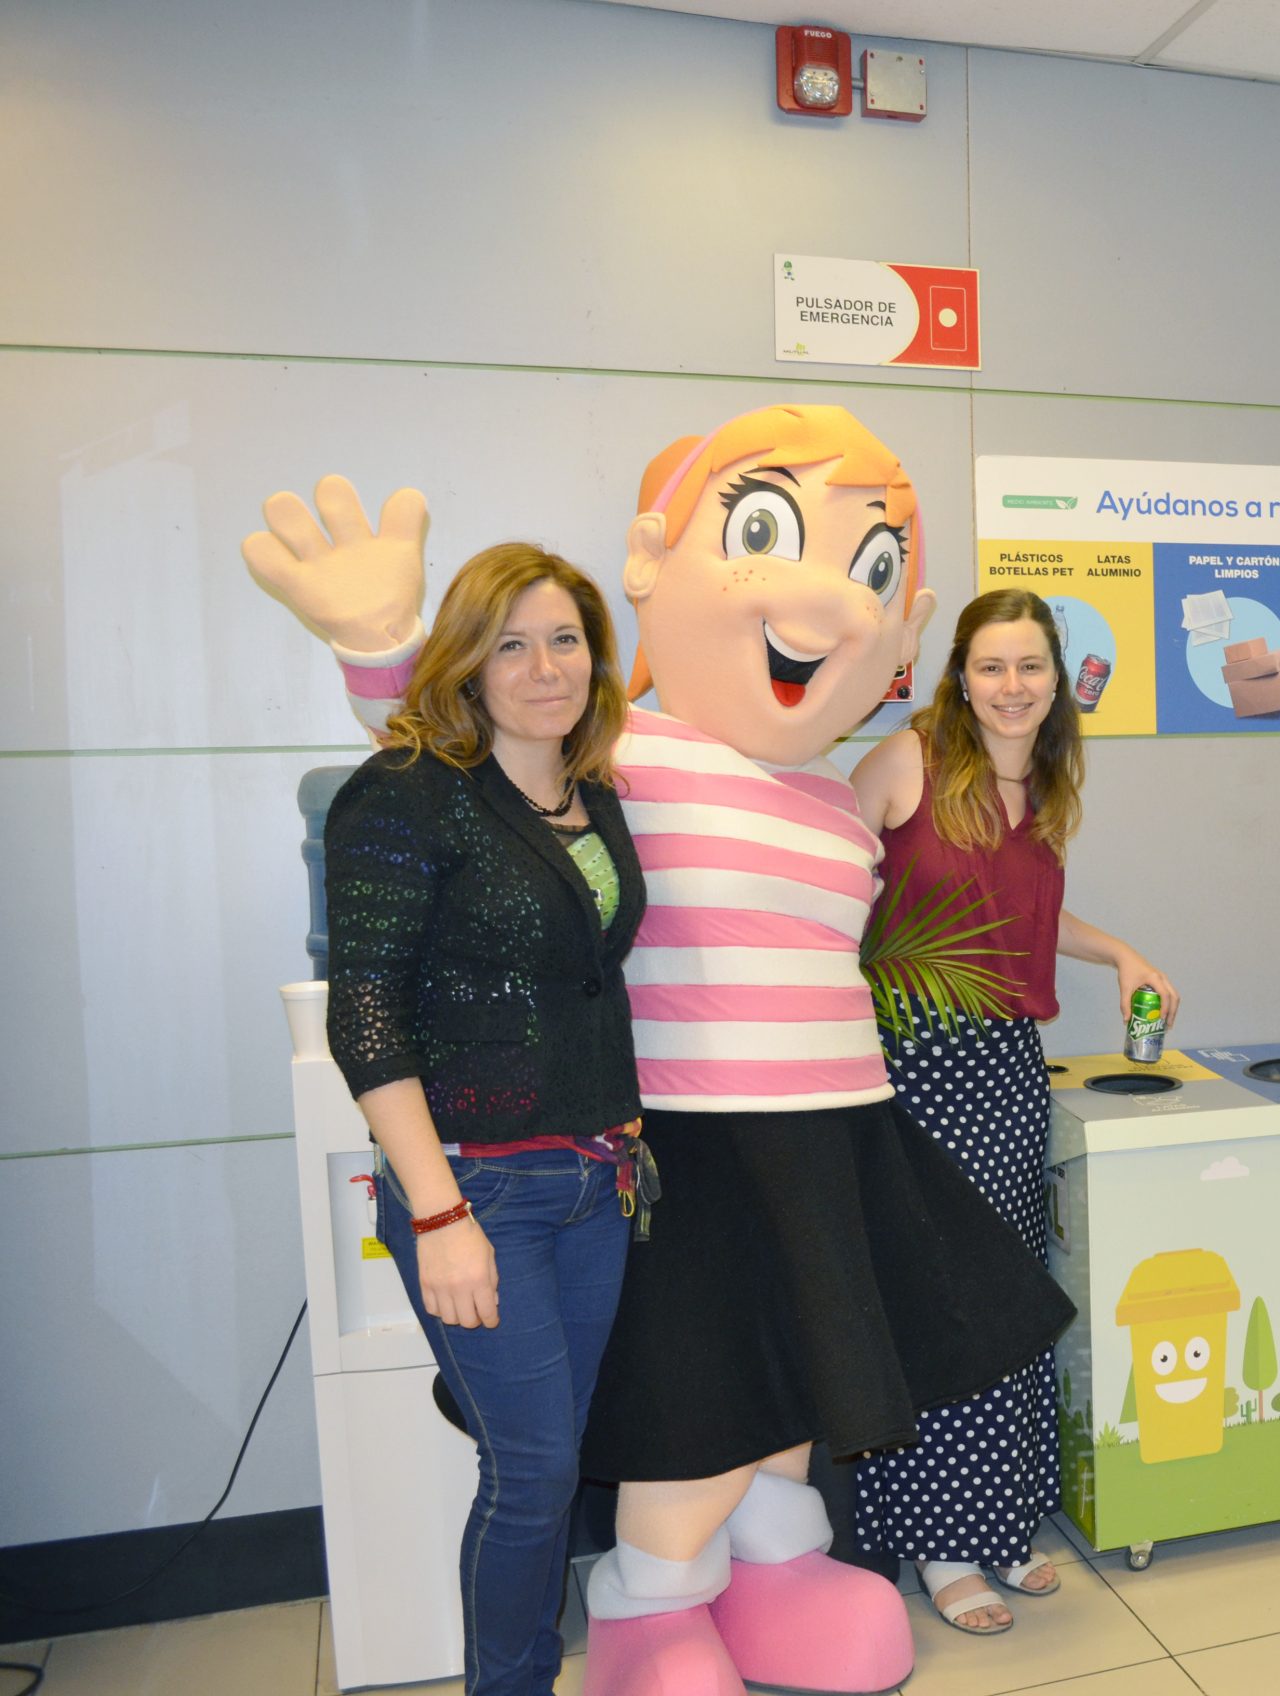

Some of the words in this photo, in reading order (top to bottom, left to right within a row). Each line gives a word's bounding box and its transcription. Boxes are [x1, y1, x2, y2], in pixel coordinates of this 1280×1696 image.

[804, 29, 832, 39] FUEGO
[796, 296, 873, 312] PULSADOR
[878, 301, 897, 313] DE
[800, 310, 894, 327] EMERGENCIA
[1096, 490, 1239, 521] Ayúdanos
[1245, 499, 1262, 518] a
[1000, 551, 1064, 563] PLÁSTICOS
[1097, 555, 1131, 564] LATAS
[1188, 555, 1224, 566] PAPEL
[1226, 556, 1233, 566] Y
[1236, 554, 1280, 567] CARTÓN
[989, 566, 1049, 576] BOTELLAS
[1052, 567, 1074, 576] PET
[1087, 568, 1142, 577] ALUMINIO
[1214, 569, 1260, 579] LIMPIOS
